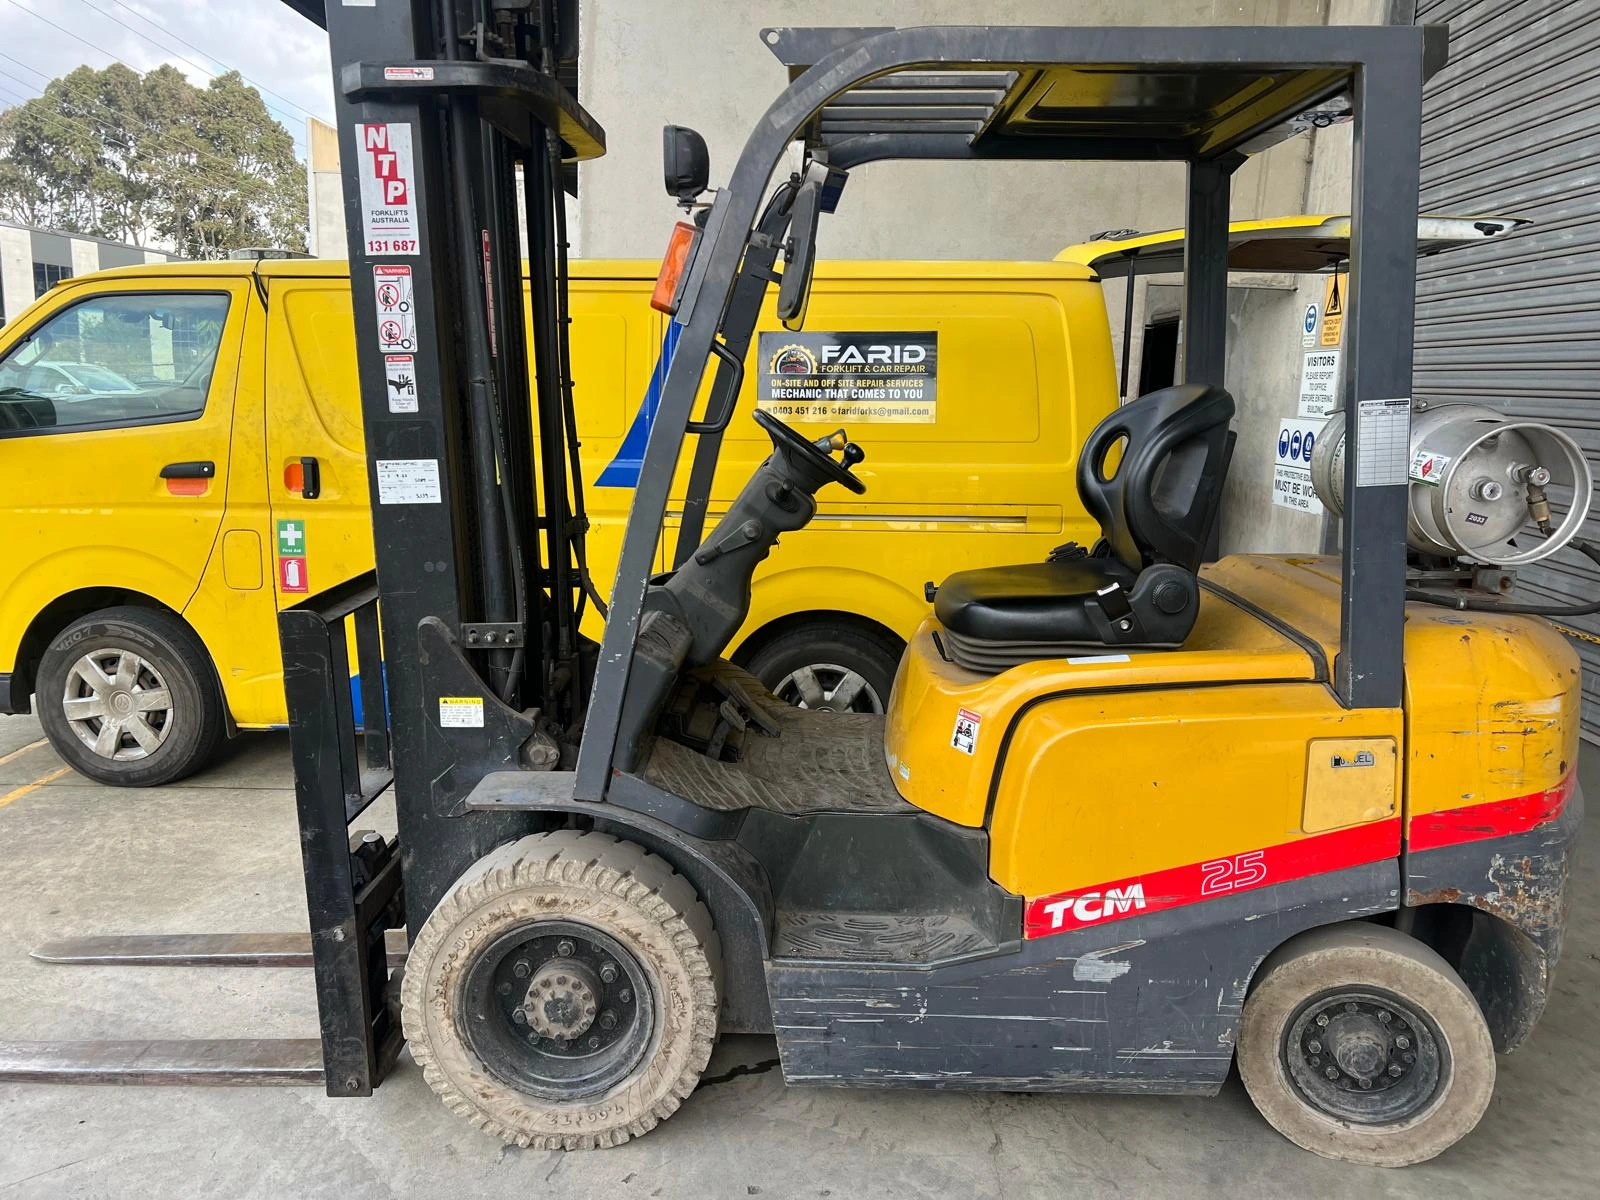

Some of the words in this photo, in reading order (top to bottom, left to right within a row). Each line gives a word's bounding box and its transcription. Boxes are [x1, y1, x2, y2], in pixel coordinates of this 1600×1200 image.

[367, 127, 406, 203] NTP
[368, 240, 389, 252] 131
[393, 240, 416, 252] 687
[821, 345, 926, 364] FARID
[1308, 356, 1335, 366] VISITORS
[821, 365, 862, 373] FORKLIFT
[864, 365, 871, 373] &
[873, 365, 892, 373] CAR
[894, 365, 925, 373] REPAIR
[1306, 372, 1319, 380] PLEASE
[1320, 371, 1334, 379] REPORT
[771, 379, 802, 388] ON-SITE
[804, 379, 819, 388] AND
[821, 379, 836, 388] OFF
[838, 379, 854, 388] SITE
[856, 379, 885, 388] REPAIR
[886, 379, 924, 387] SERVICES
[771, 389, 822, 399] MECHANIC
[825, 389, 848, 399] THAT
[852, 389, 887, 399] COMES
[889, 389, 900, 399] TO
[904, 389, 923, 398] YOU
[772, 406, 792, 414] 0403
[795, 406, 809, 414] 451
[812, 406, 828, 414] 216
[838, 407, 929, 416] faridforks@gmail.com
[1275, 479, 1291, 492] MUST
[1292, 482, 1301, 495] BE
[1298, 499, 1309, 508] AREA
[1468, 514, 1485, 523] 2033
[1200, 850, 1267, 896] 25
[1042, 883, 1147, 929] TCM
